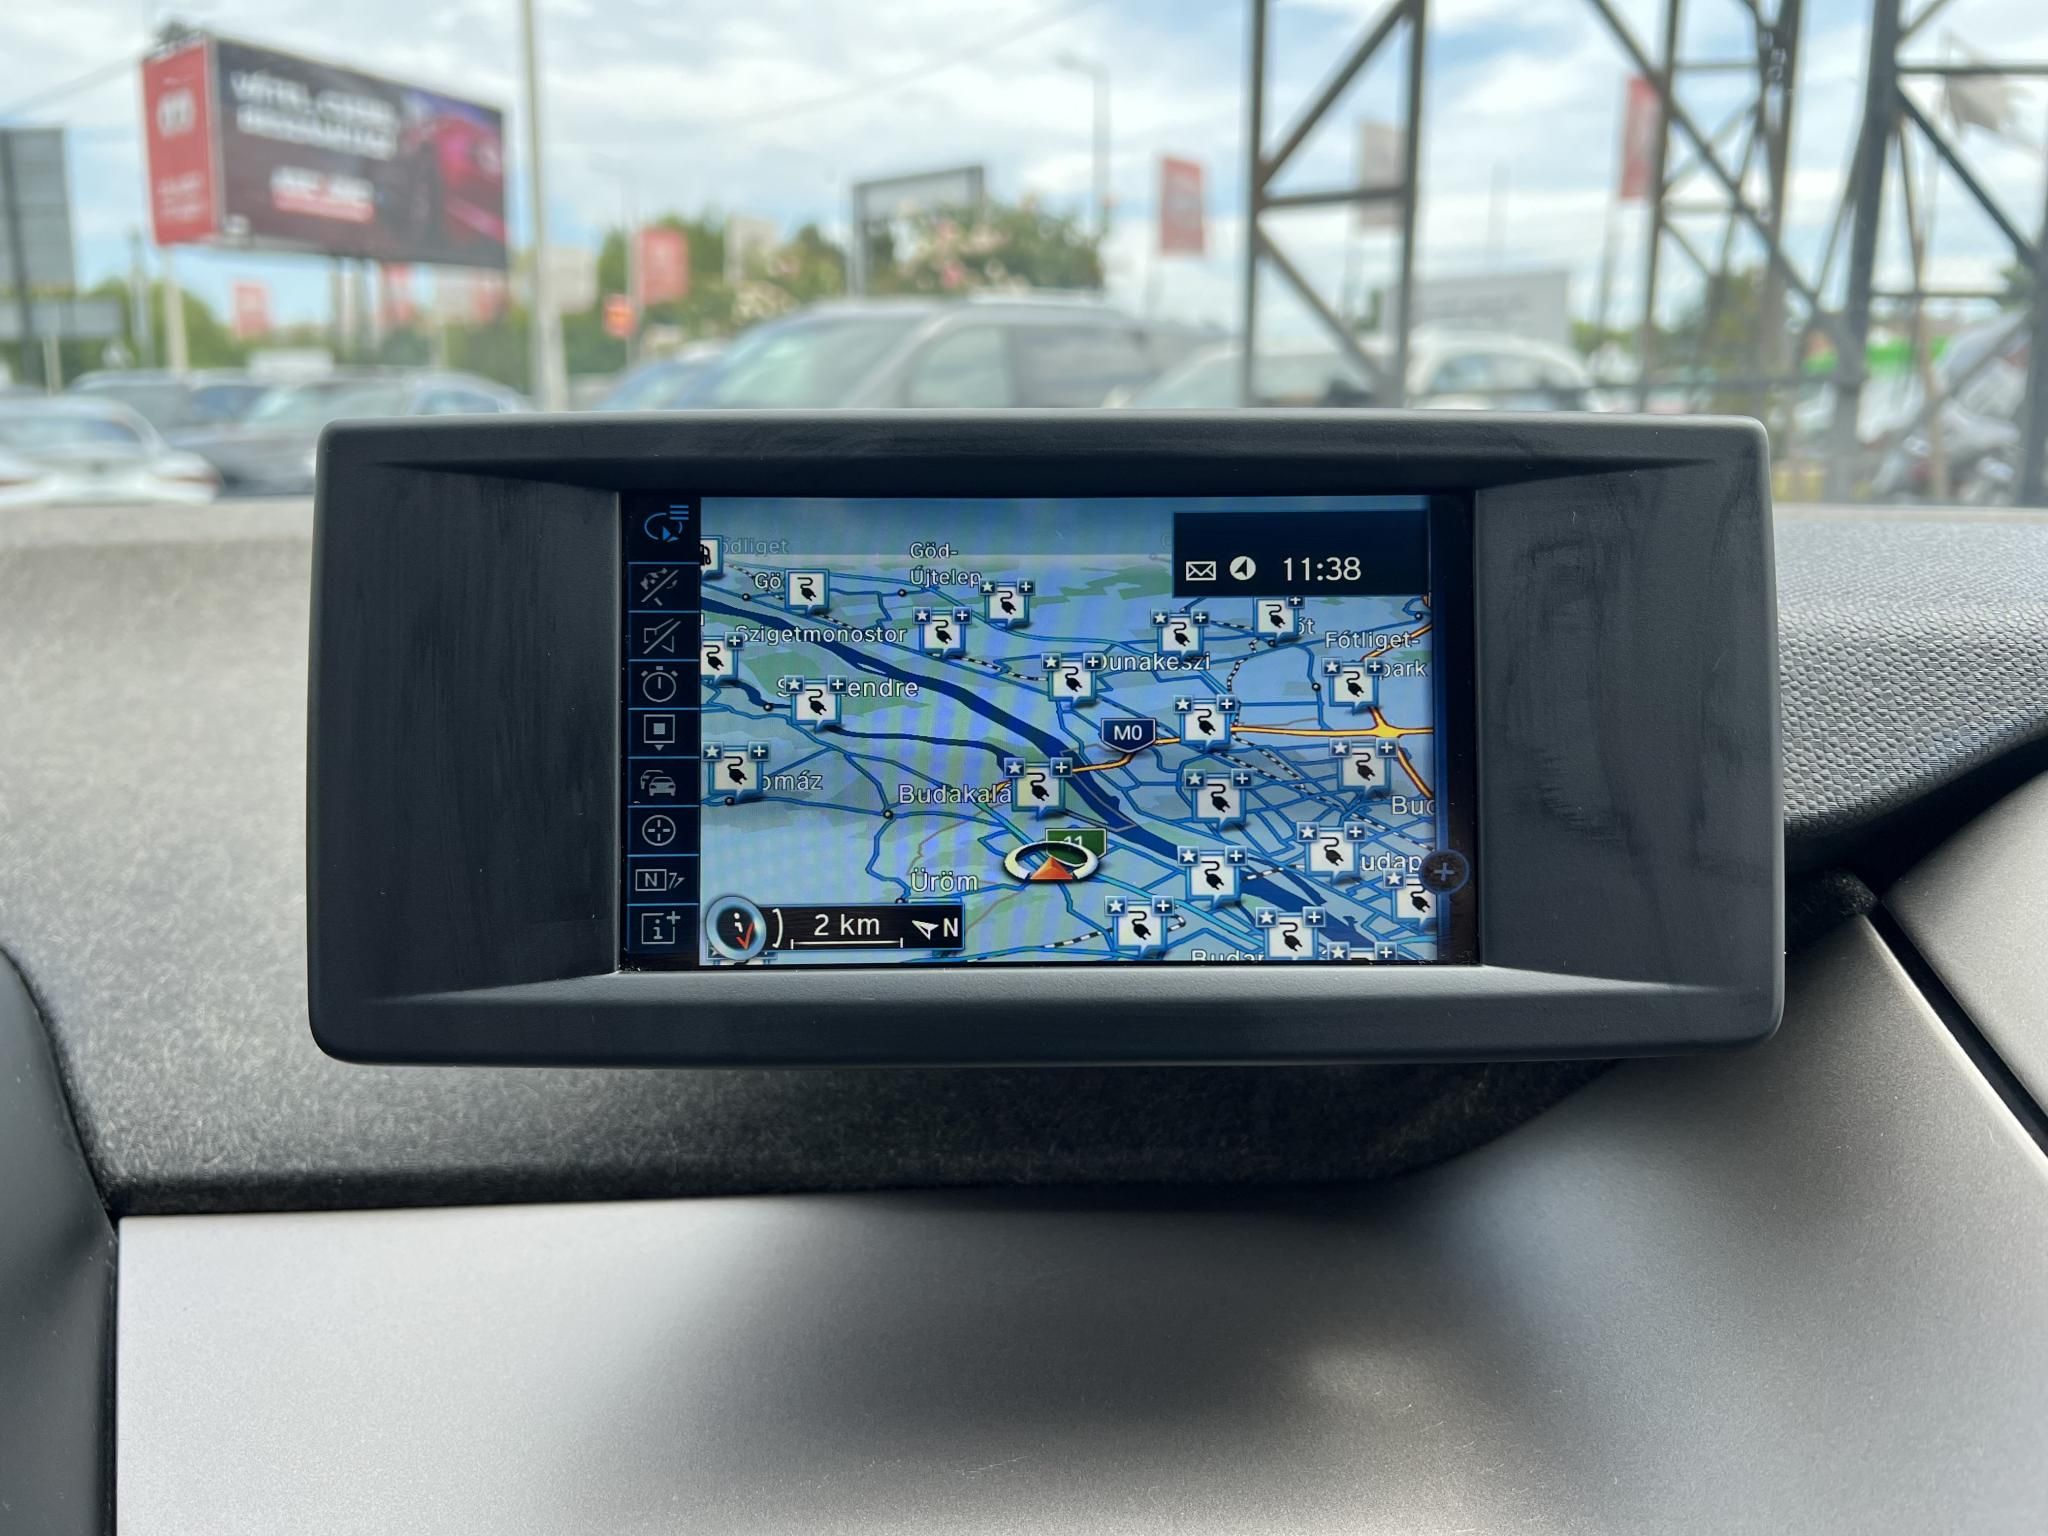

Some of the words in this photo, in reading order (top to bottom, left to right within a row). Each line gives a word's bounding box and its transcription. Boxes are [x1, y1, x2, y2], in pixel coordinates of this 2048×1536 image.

[910, 541, 958, 559] Göd-
[910, 567, 981, 587] Újtelep
[1283, 557, 1362, 582] 11:38
[735, 624, 907, 646] Szigetmonostor
[1325, 630, 1419, 651] Fótliget-
[1113, 725, 1143, 742] M0
[910, 869, 979, 892] Üröm
[814, 914, 830, 936] 2
[840, 913, 880, 935] km
[944, 918, 960, 937] N
